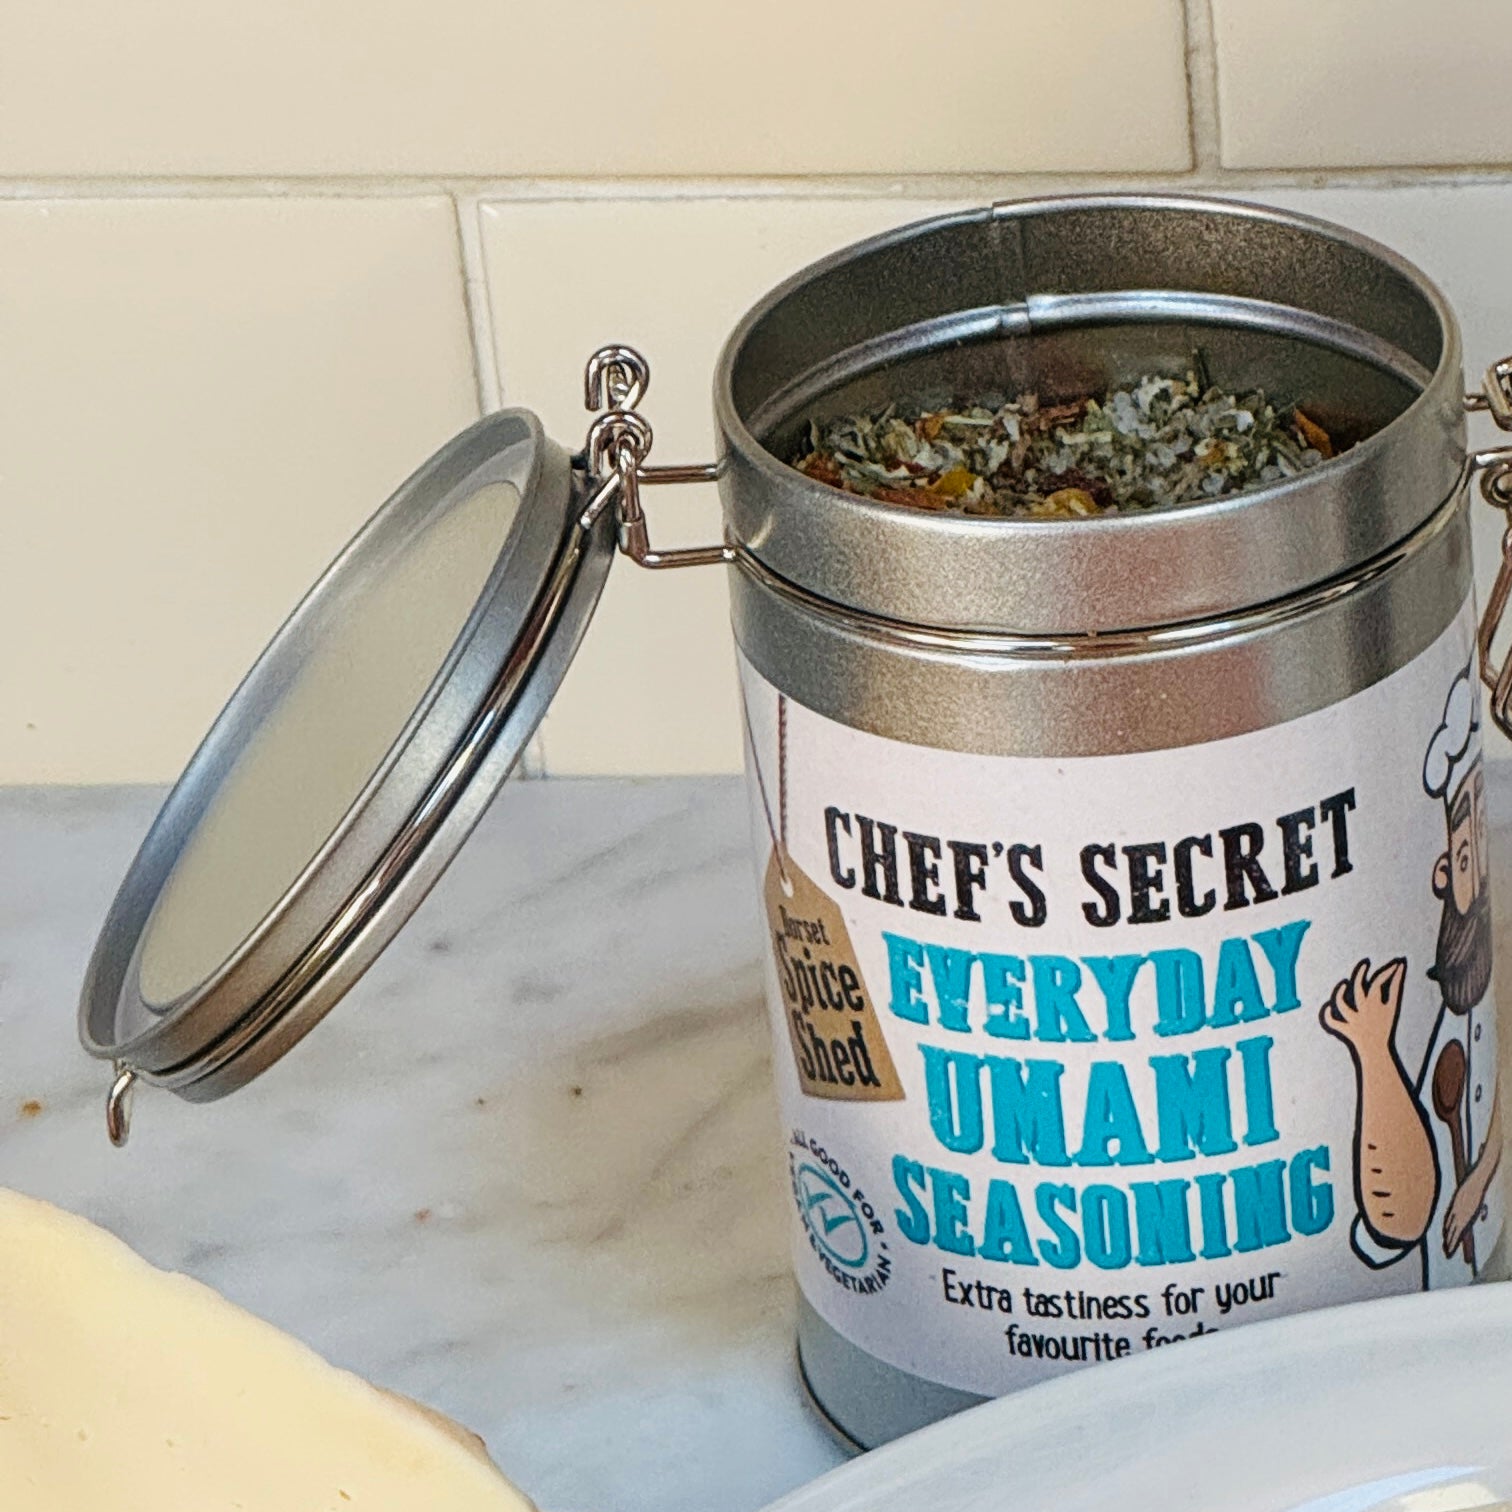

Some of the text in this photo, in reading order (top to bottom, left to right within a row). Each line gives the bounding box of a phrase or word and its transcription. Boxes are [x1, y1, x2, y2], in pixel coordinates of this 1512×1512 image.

[824, 787, 1356, 928] CHEF'S SECRET
[776, 930, 864, 1015] Spice
[881, 920, 1312, 1043] EVERYDAY
[791, 1008, 882, 1087] Shed
[917, 1035, 1280, 1167] UMAMI
[809, 1138, 851, 1189] GOOD
[853, 1188, 885, 1236] FOR
[891, 1144, 1334, 1270] SEASONING
[942, 1267, 1281, 1320] Extra tastiness for your
[1005, 1323, 1131, 1361] favourite
